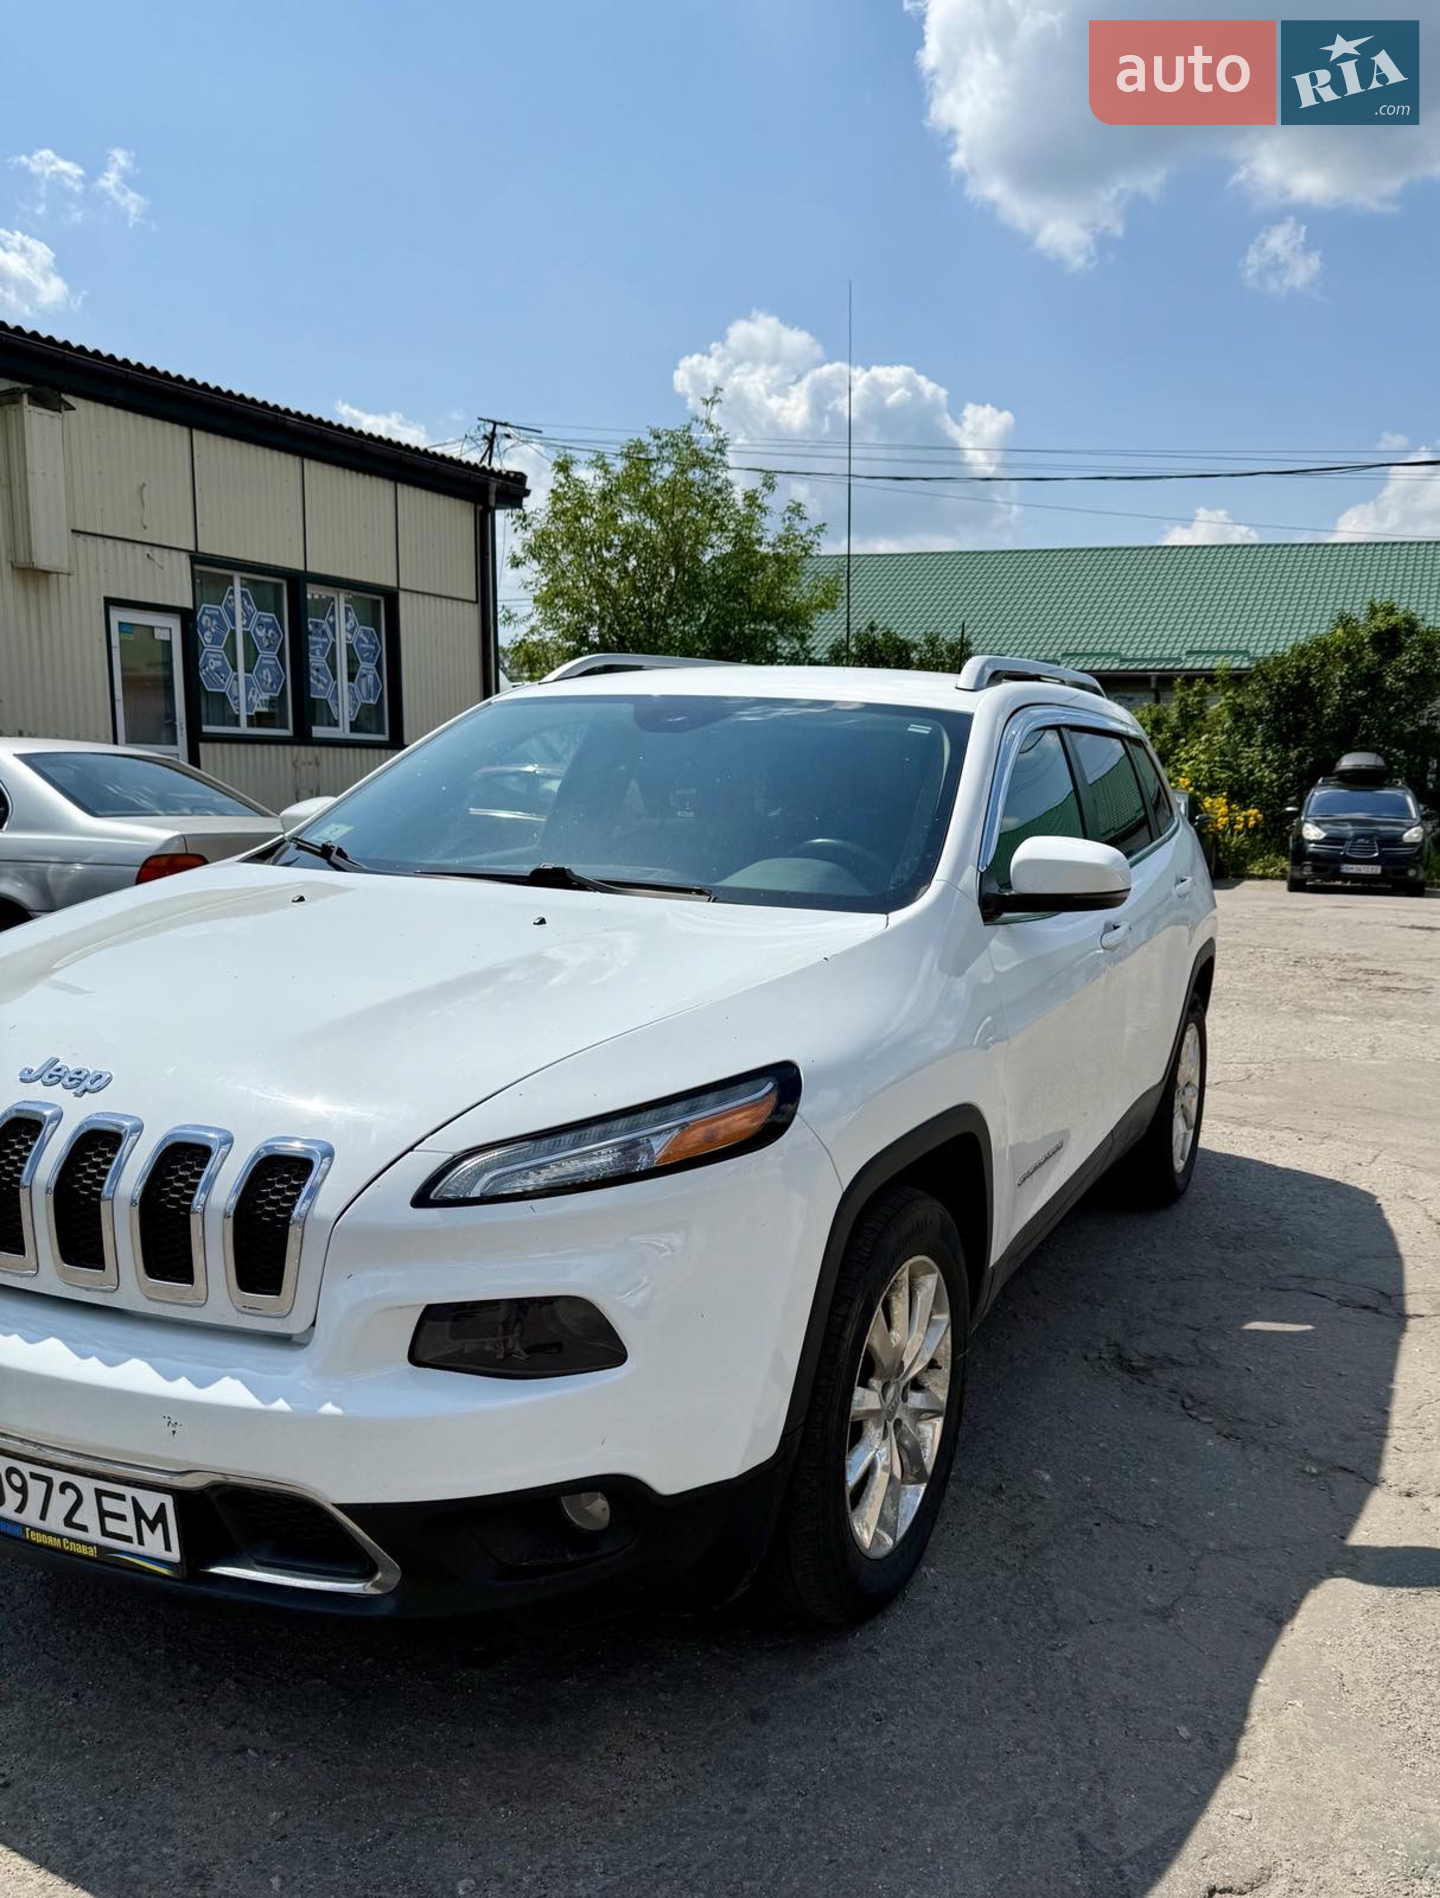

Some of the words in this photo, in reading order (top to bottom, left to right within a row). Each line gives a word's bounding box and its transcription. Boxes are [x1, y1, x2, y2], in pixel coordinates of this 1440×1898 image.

[19, 1056, 113, 1098] Jeep
[0, 1465, 173, 1553] 972EM
[25, 1527, 62, 1548] Героям
[62, 1538, 98, 1558] Слава!
